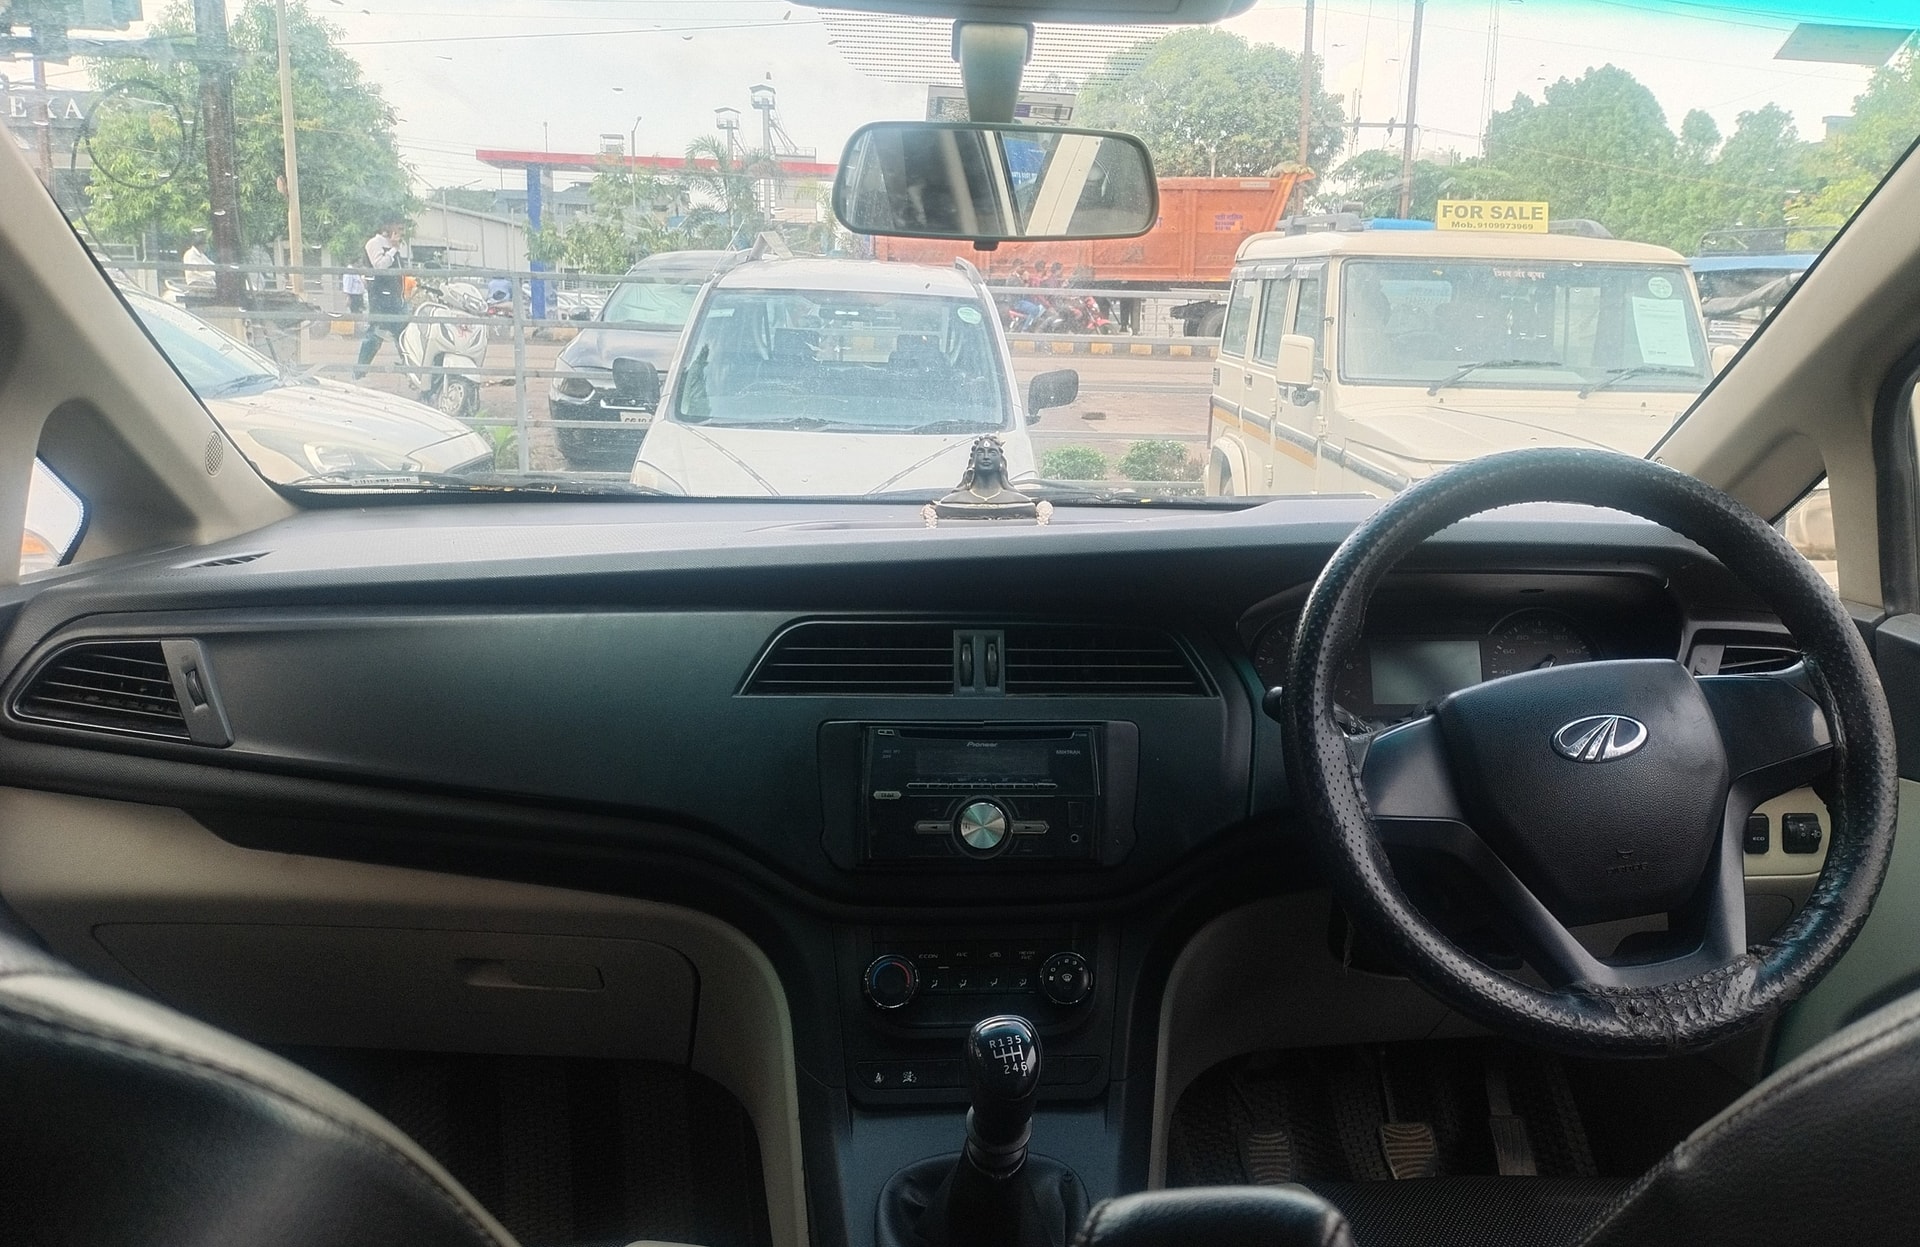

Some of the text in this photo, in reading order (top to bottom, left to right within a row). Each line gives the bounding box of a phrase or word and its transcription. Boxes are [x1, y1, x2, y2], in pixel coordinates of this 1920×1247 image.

[1442, 205, 1544, 221] FOR SALE
[989, 1034, 1022, 1049] R 1 3 5
[1003, 1061, 1028, 1075] 2 4 6
